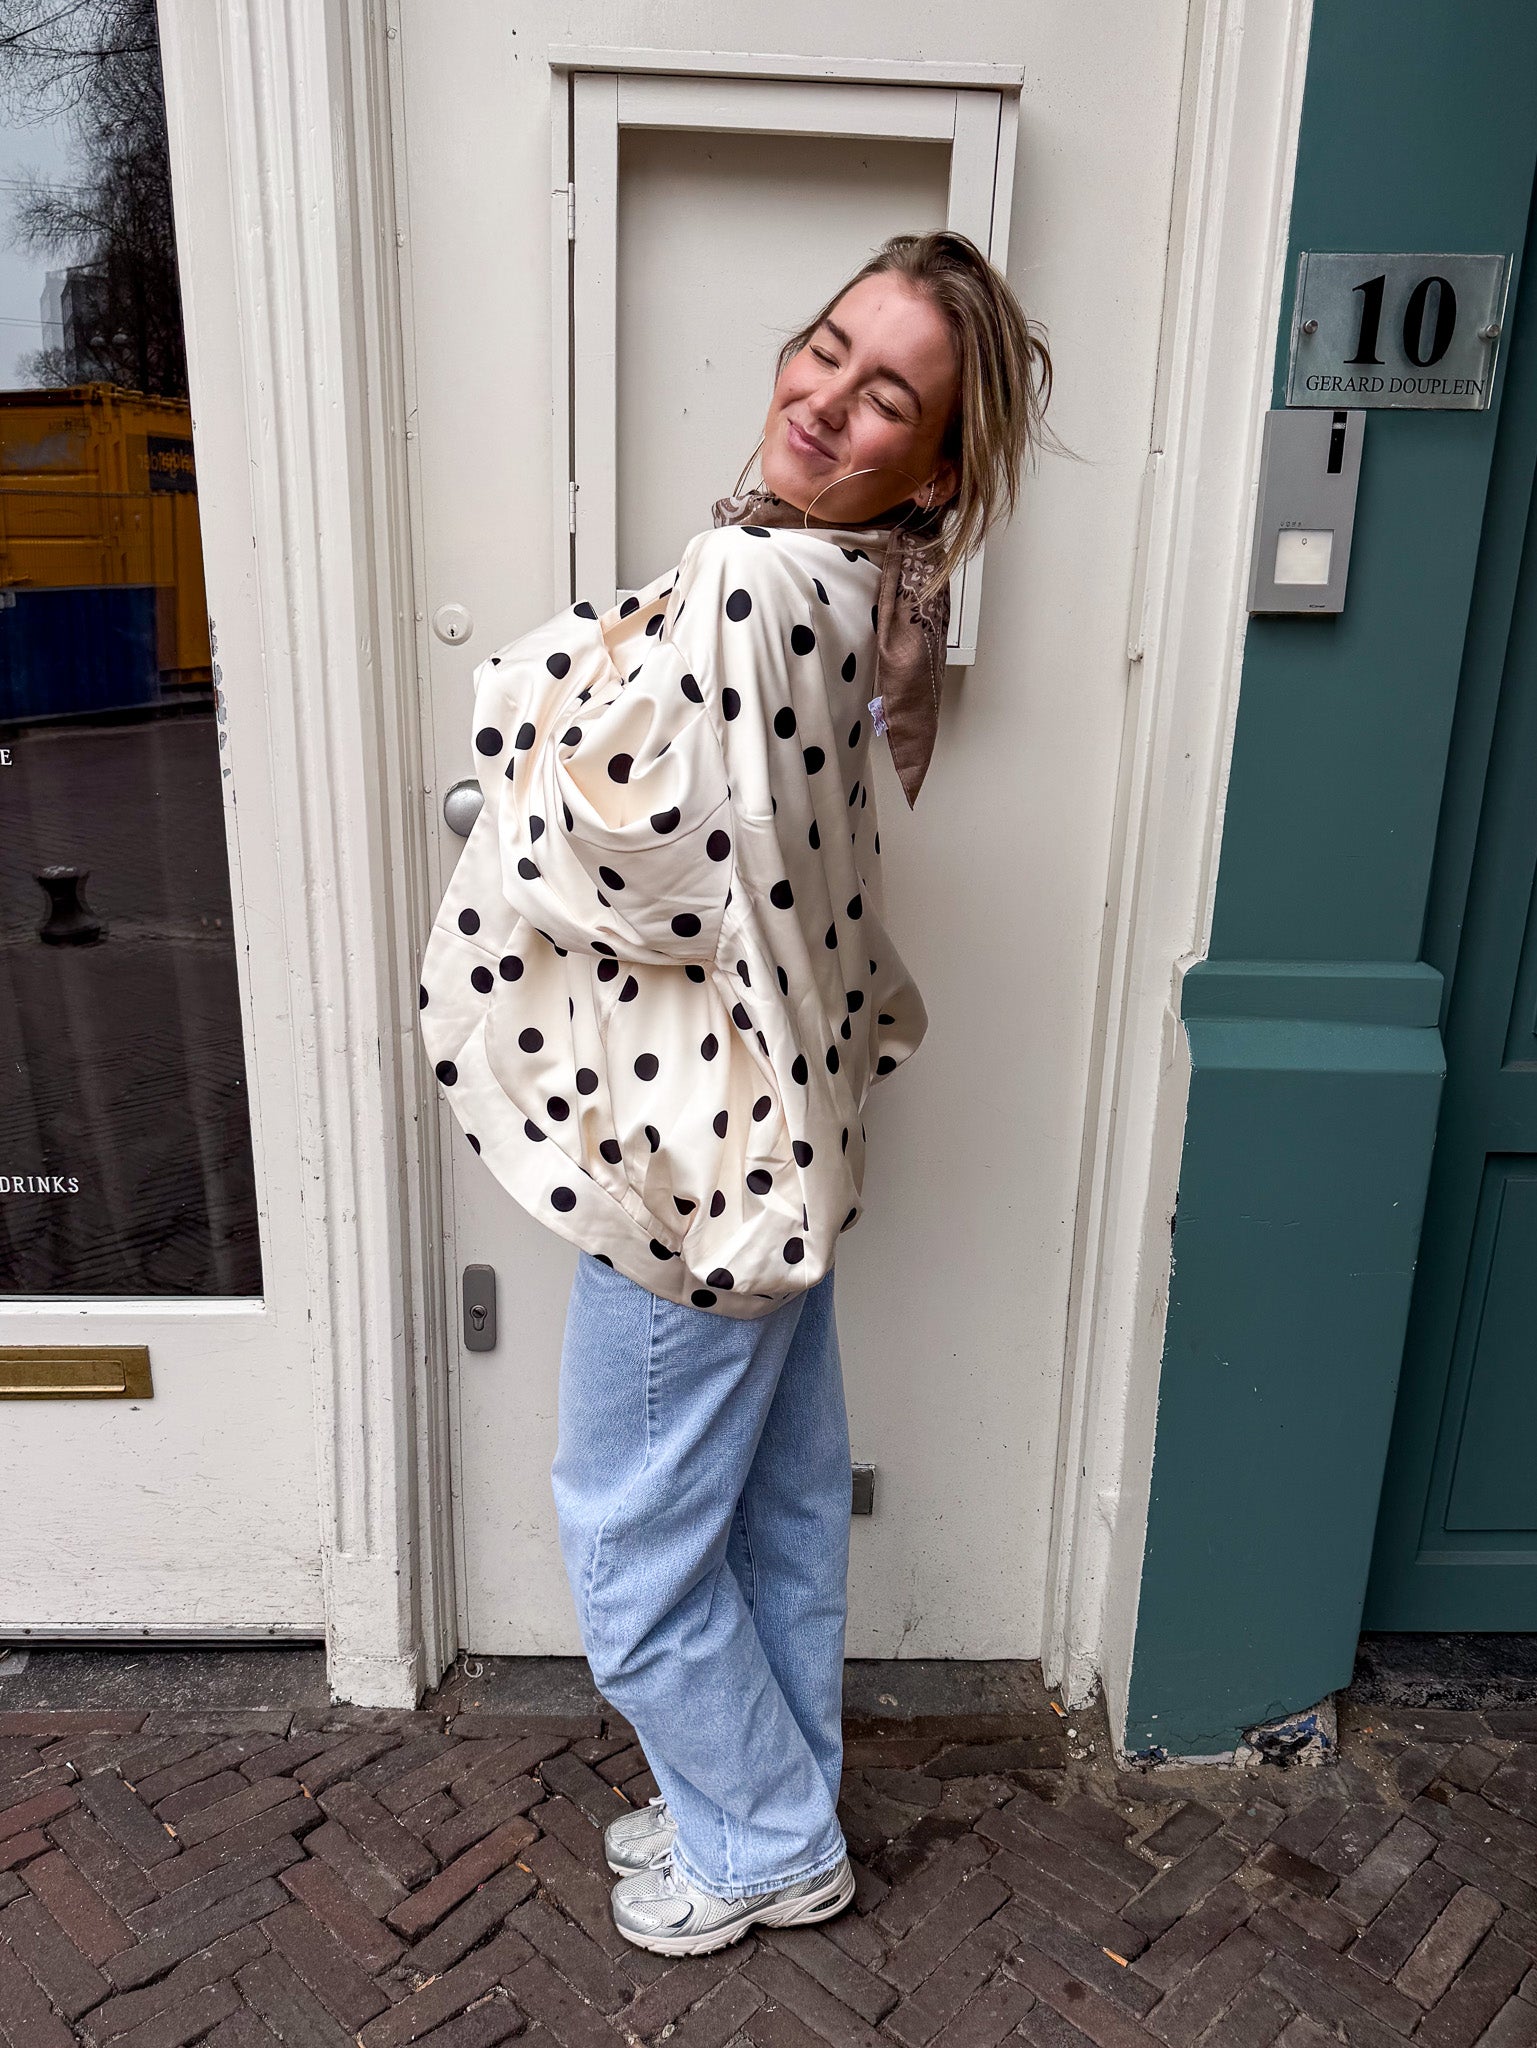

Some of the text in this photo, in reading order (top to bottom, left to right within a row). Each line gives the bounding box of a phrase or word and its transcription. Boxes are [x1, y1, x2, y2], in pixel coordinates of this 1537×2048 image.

[1343, 274, 1457, 367] 10
[1306, 375, 1485, 396] GERARD DOUPLEIN
[0, 1176, 79, 1193] DRINKS
